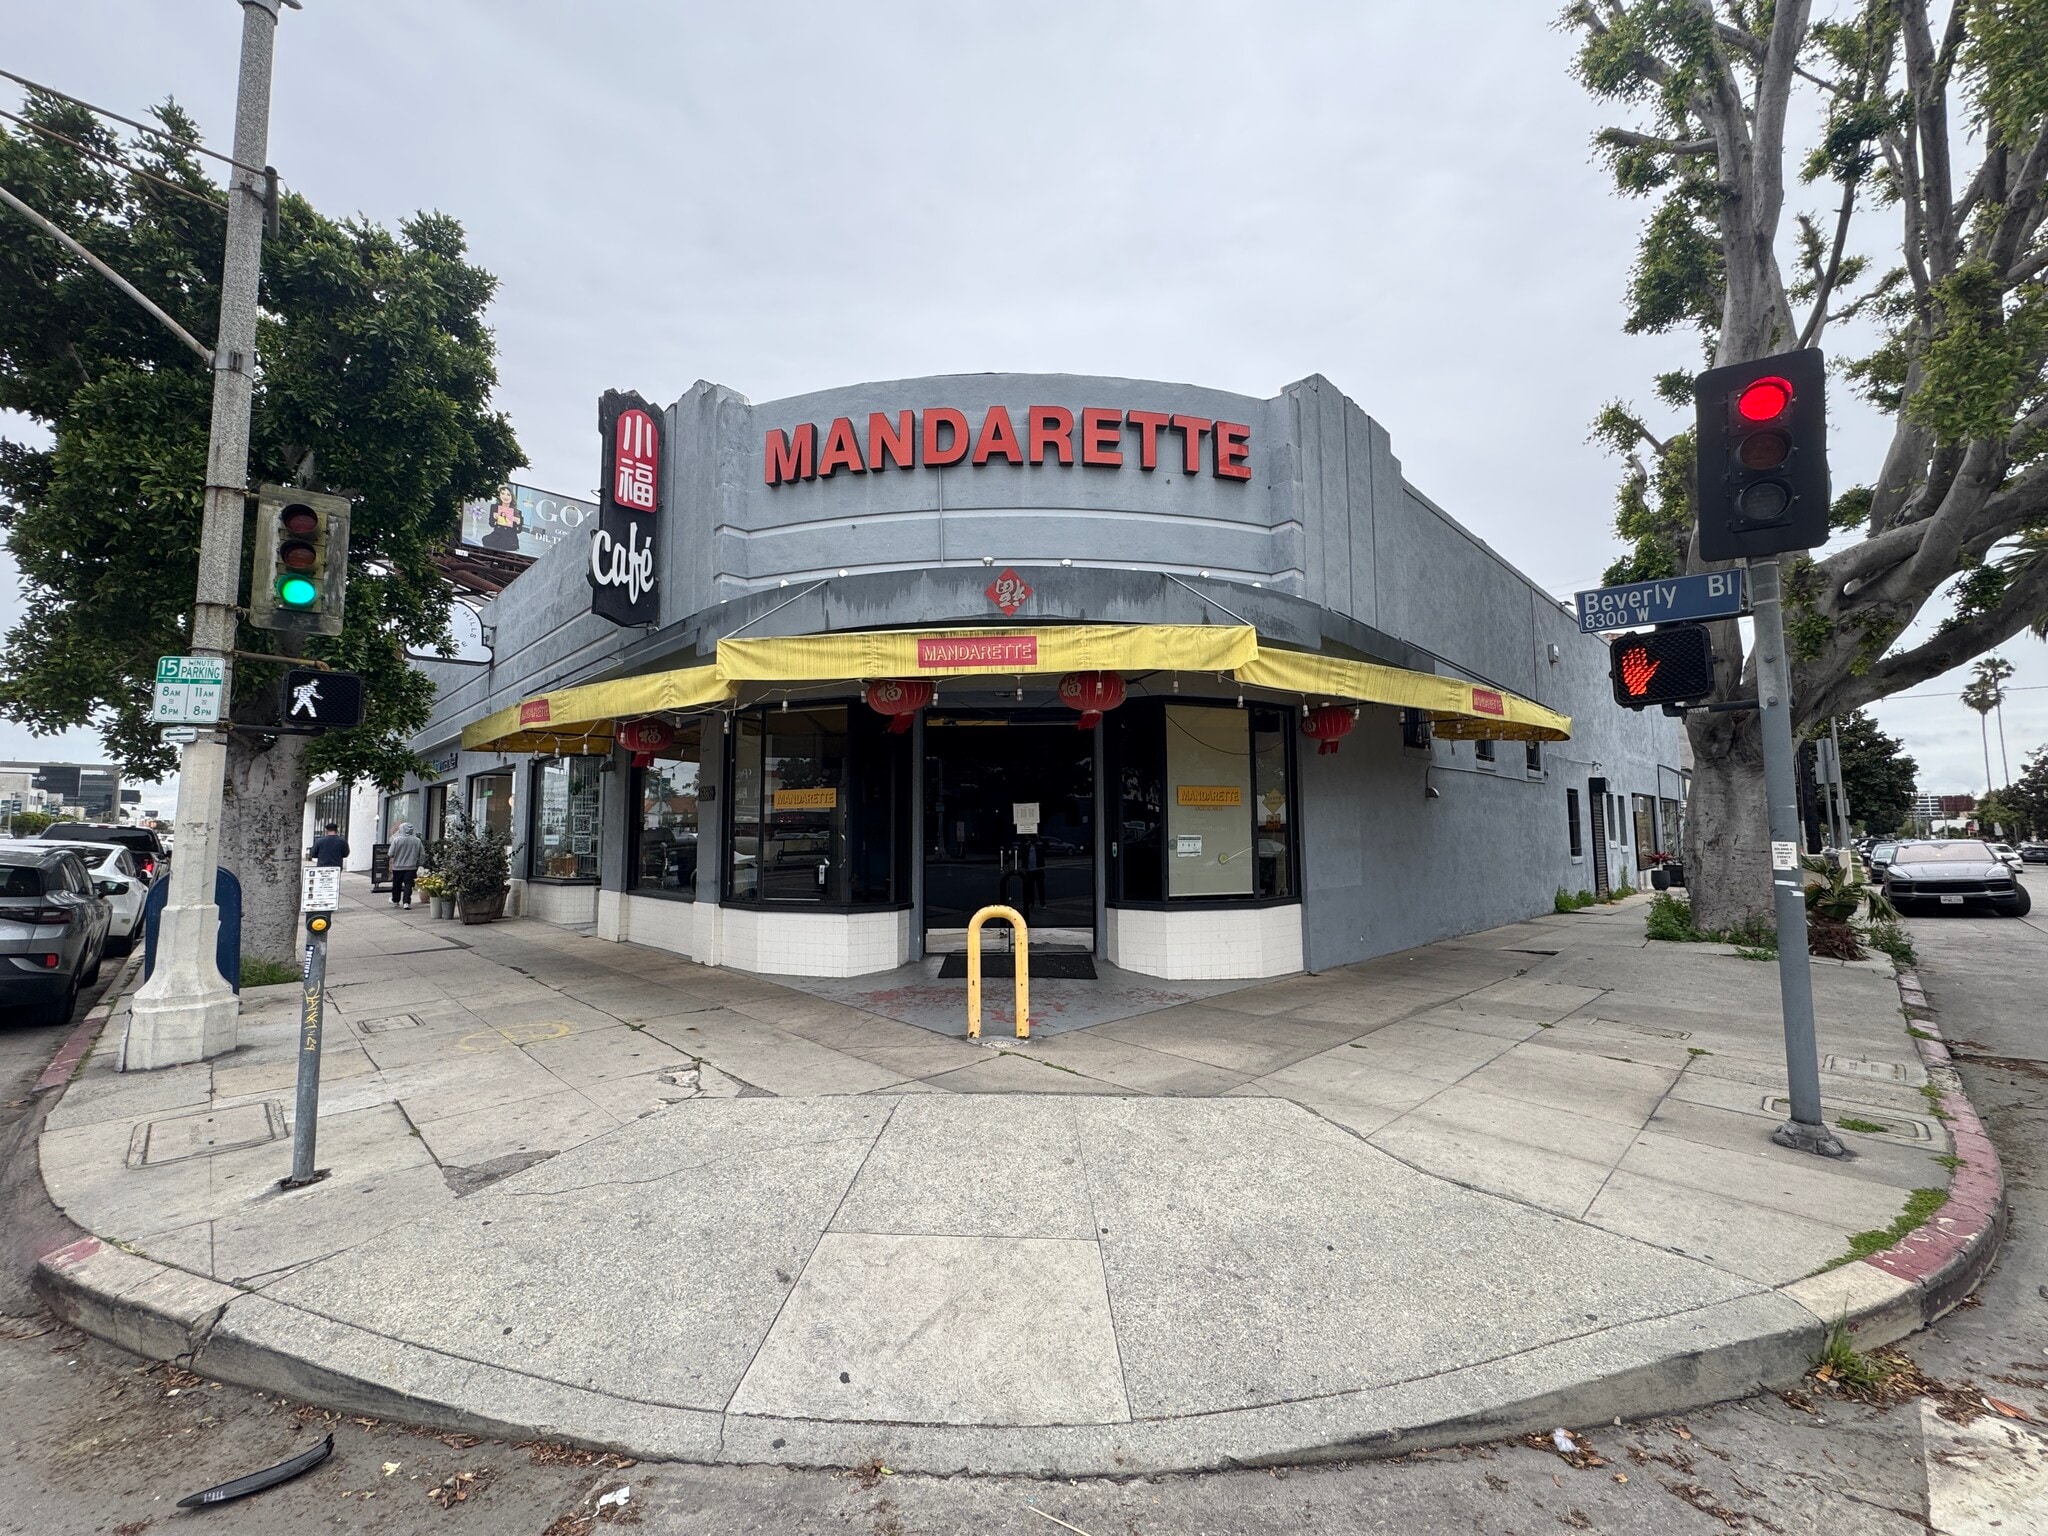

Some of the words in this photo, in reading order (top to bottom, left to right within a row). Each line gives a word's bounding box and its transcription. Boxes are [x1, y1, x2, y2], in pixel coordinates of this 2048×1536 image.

[764, 405, 1252, 487] MANDARETTE
[619, 415, 653, 507] 小福
[592, 522, 654, 604] Café
[1584, 583, 1677, 614] Beverly
[1707, 573, 1733, 598] Bl
[462, 611, 477, 639] HILLS
[1585, 610, 1628, 629] 8300
[1636, 607, 1650, 622] W
[923, 643, 1032, 661] MANDARETTE
[161, 659, 178, 676] 15
[181, 667, 220, 679] PARKING
[777, 792, 834, 805] MANDARETTE
[1181, 790, 1239, 802] MANDARETTE
